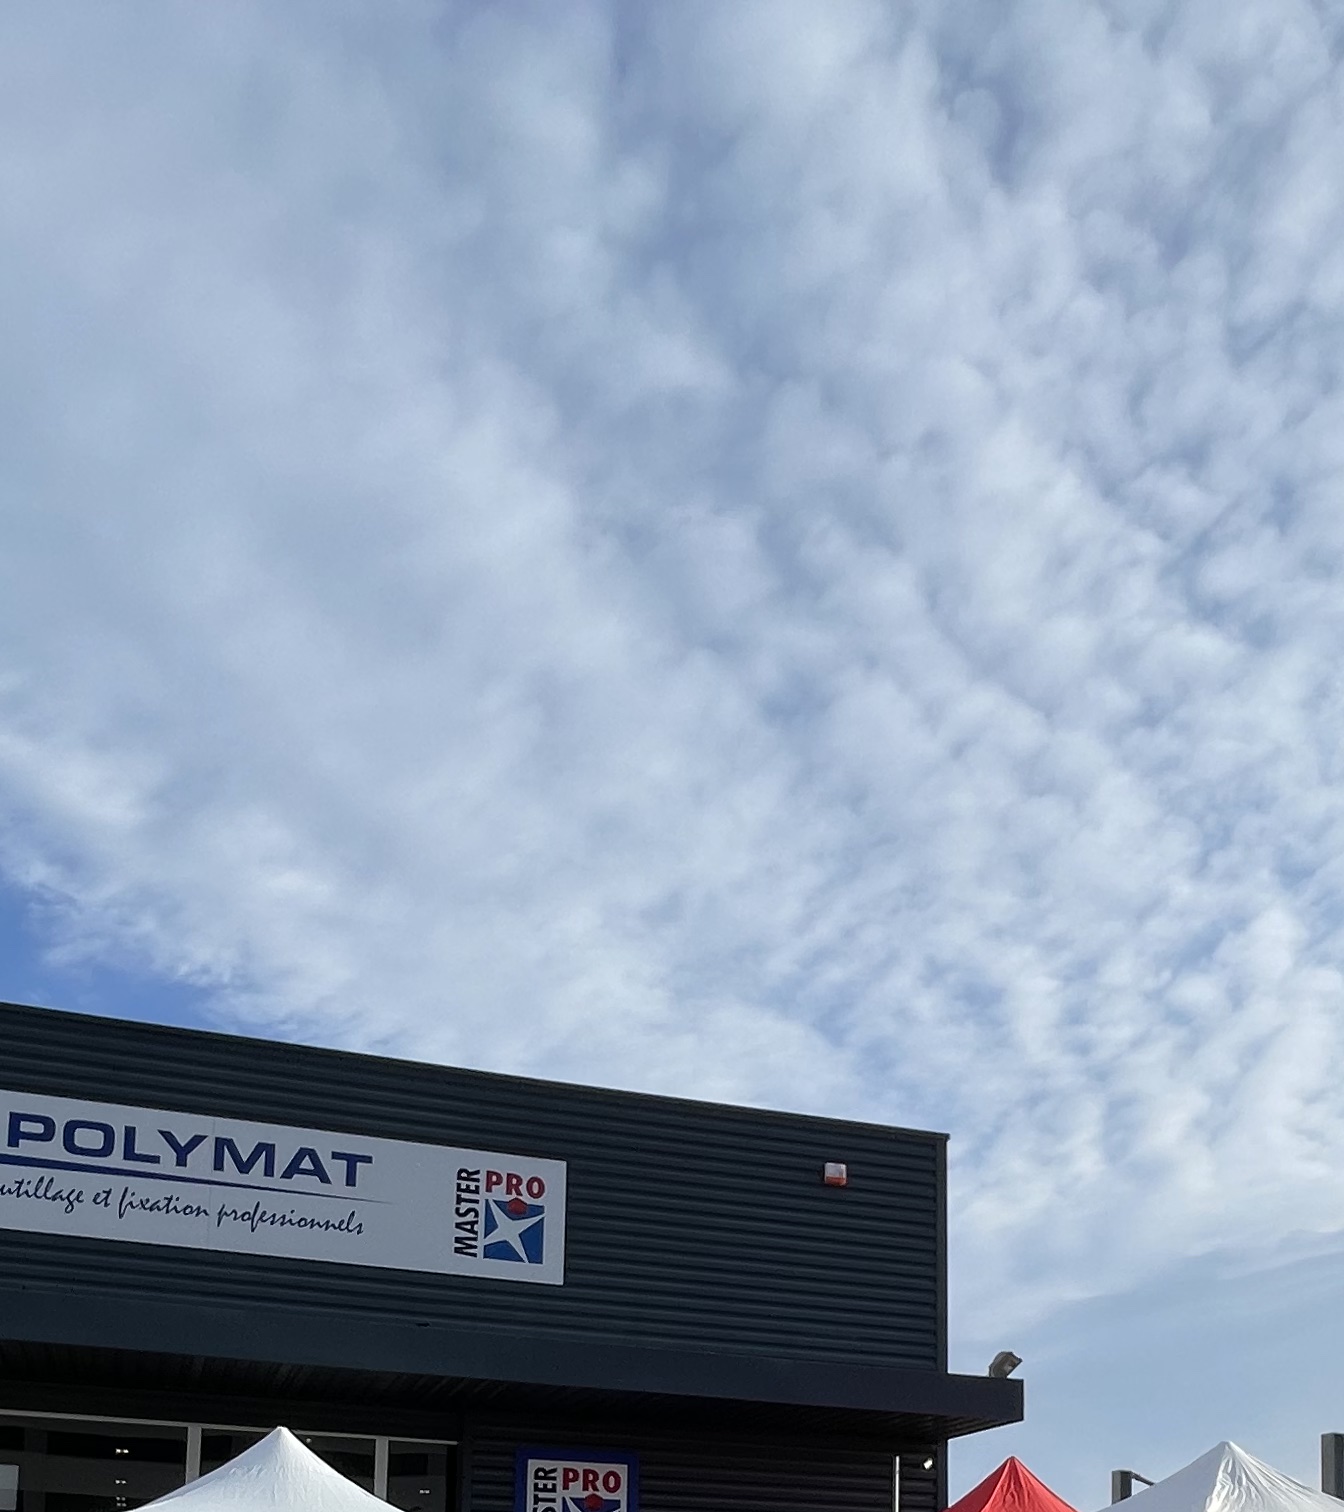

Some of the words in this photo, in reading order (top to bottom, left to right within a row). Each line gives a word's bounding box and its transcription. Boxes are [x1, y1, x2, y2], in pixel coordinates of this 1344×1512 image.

[6, 1111, 374, 1188] POLYMAT
[485, 1170, 546, 1200] PRO
[92, 1189, 112, 1209] et
[118, 1186, 210, 1219] fixation
[216, 1200, 365, 1236] professionnels
[453, 1167, 481, 1259] MASTER
[562, 1467, 622, 1494] PRO
